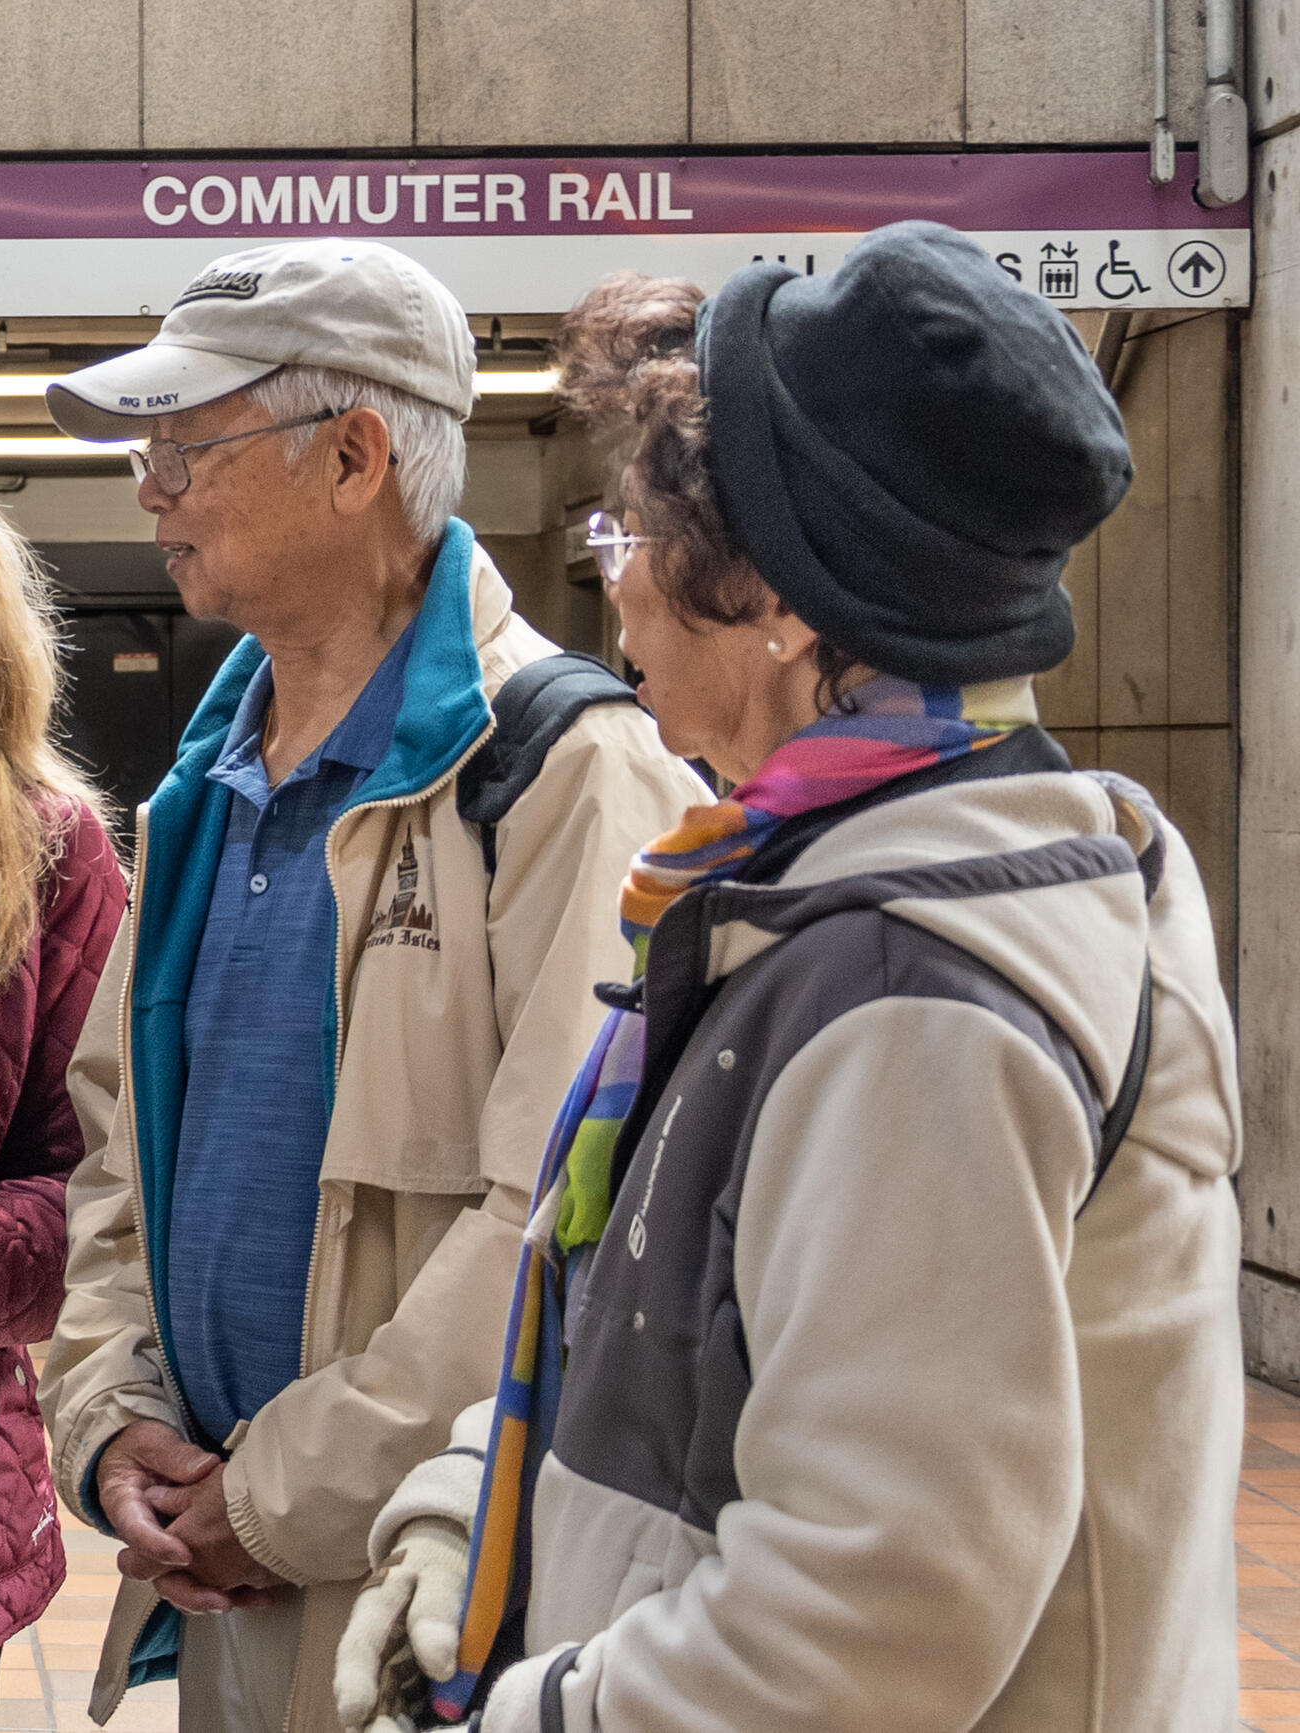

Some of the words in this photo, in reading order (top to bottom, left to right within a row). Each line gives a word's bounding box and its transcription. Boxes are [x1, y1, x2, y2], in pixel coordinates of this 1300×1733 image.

[142, 174, 526, 226] COMMUTER
[548, 172, 694, 221] RAIL
[119, 396, 140, 408] BIG
[146, 392, 179, 408] EASY
[397, 929, 441, 952] Isles
